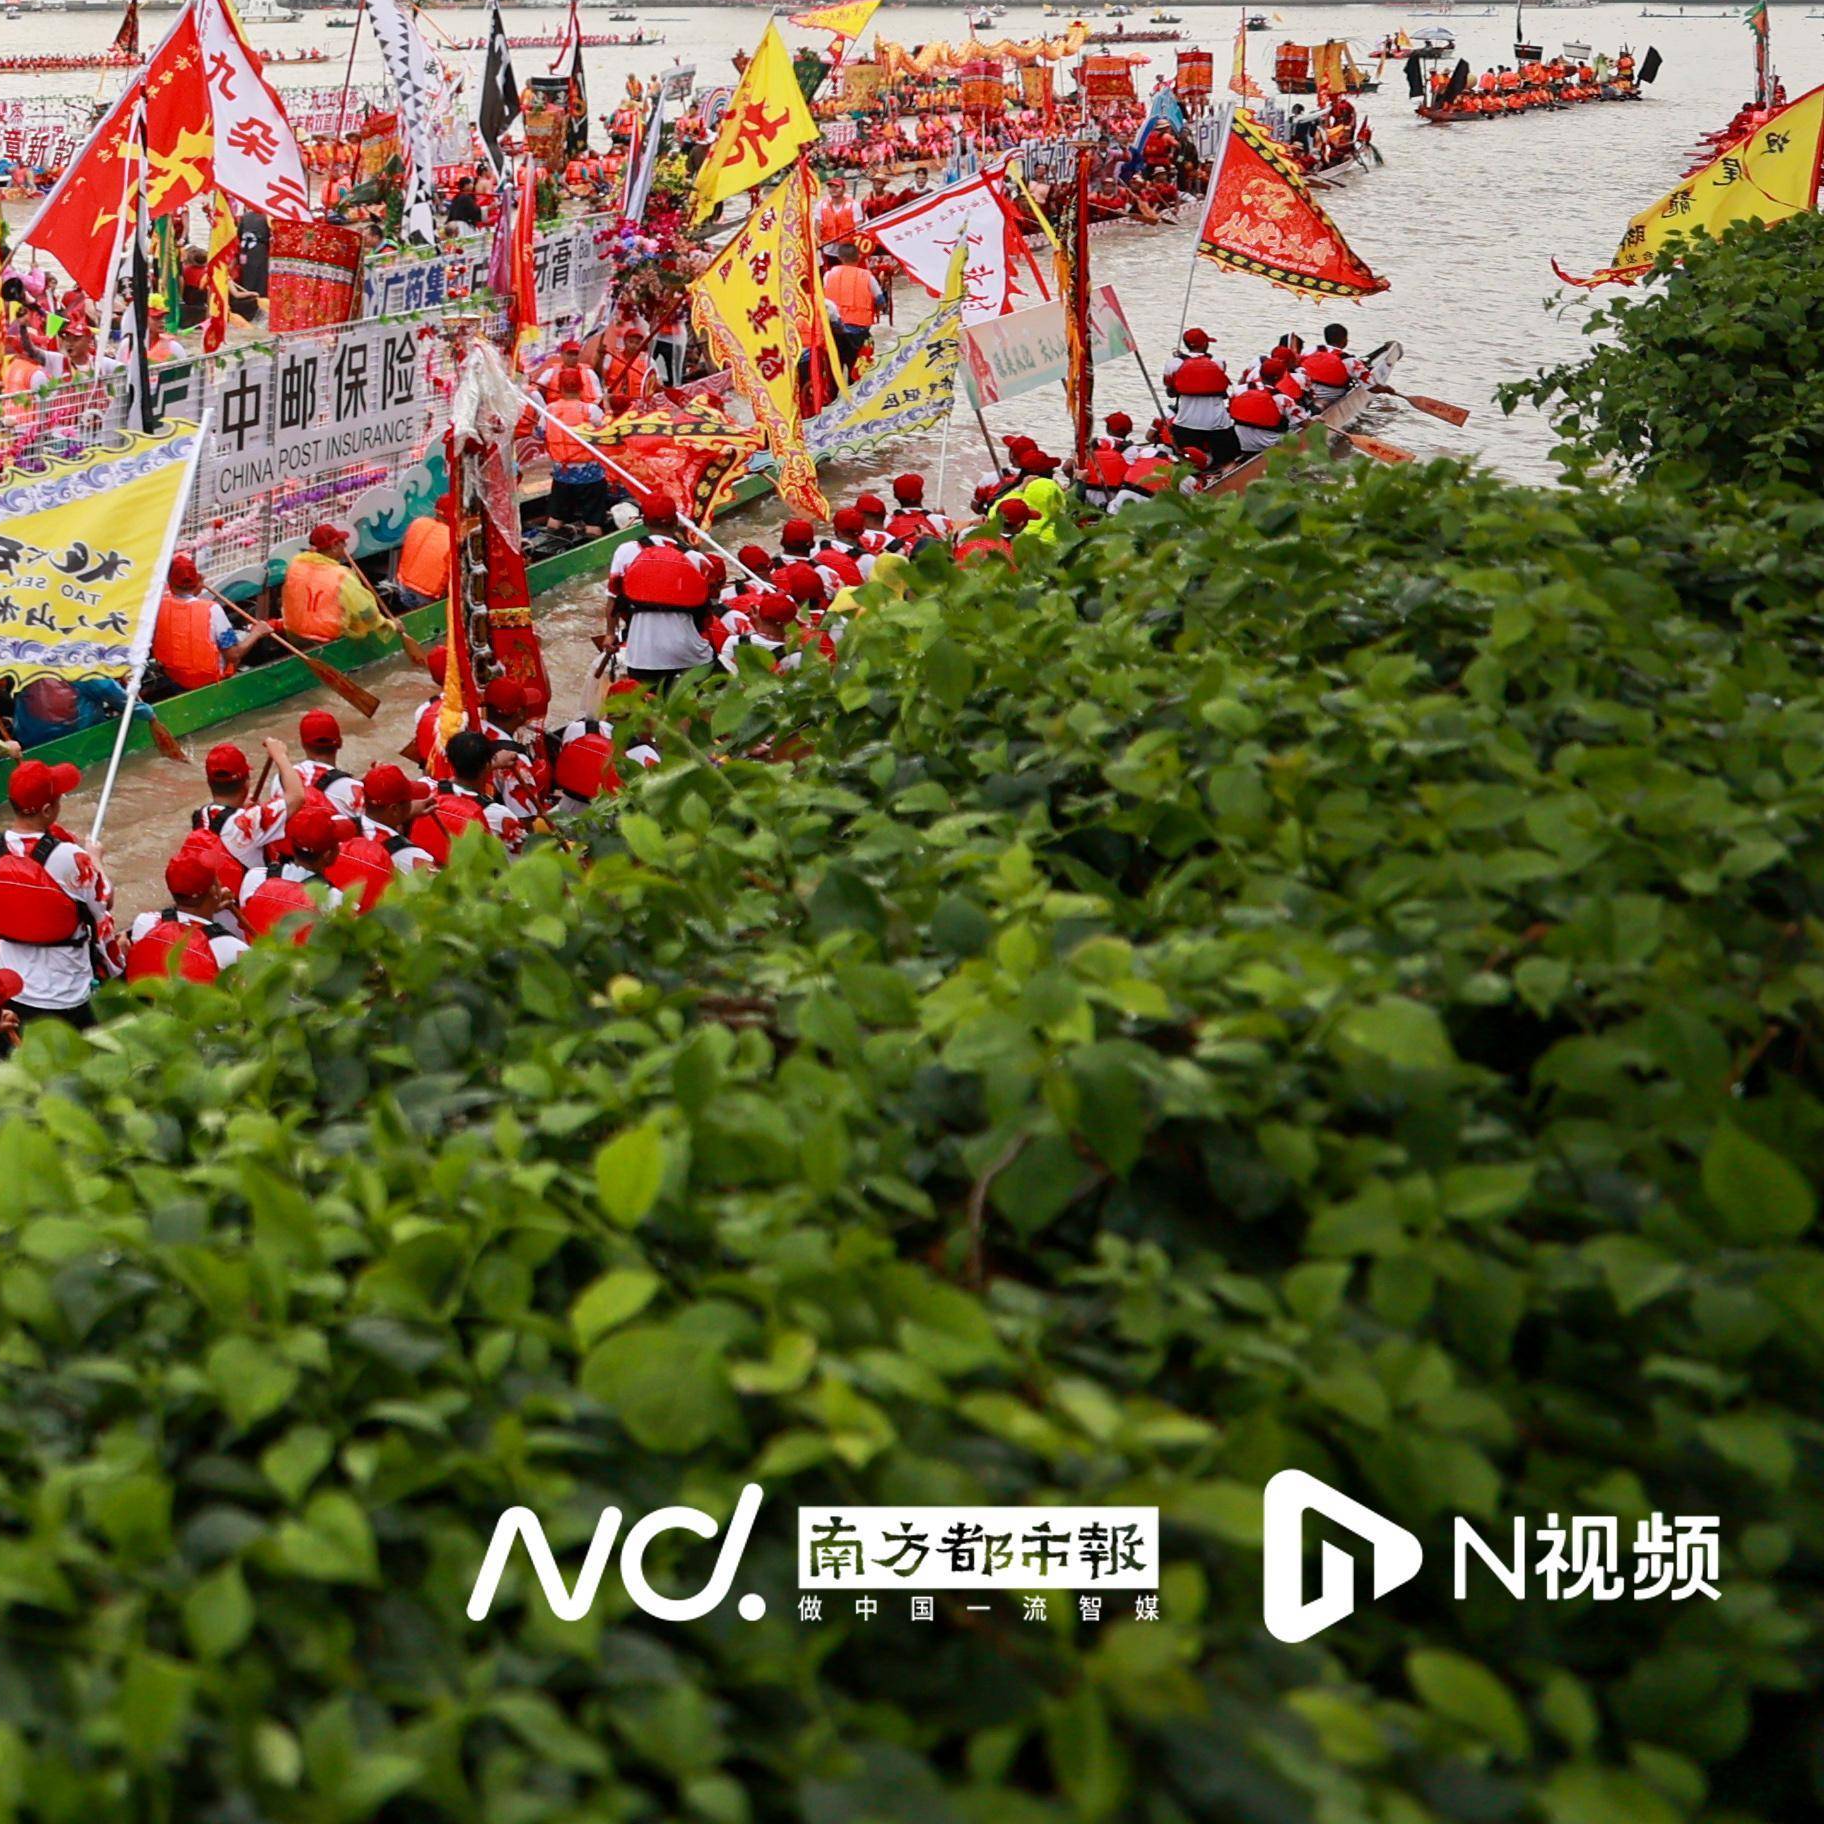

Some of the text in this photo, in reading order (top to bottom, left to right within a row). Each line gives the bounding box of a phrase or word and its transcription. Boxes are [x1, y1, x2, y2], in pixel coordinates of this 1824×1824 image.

[220, 334, 419, 452] 中邮保险
[220, 416, 415, 495] CHINA POST INSURANCE
